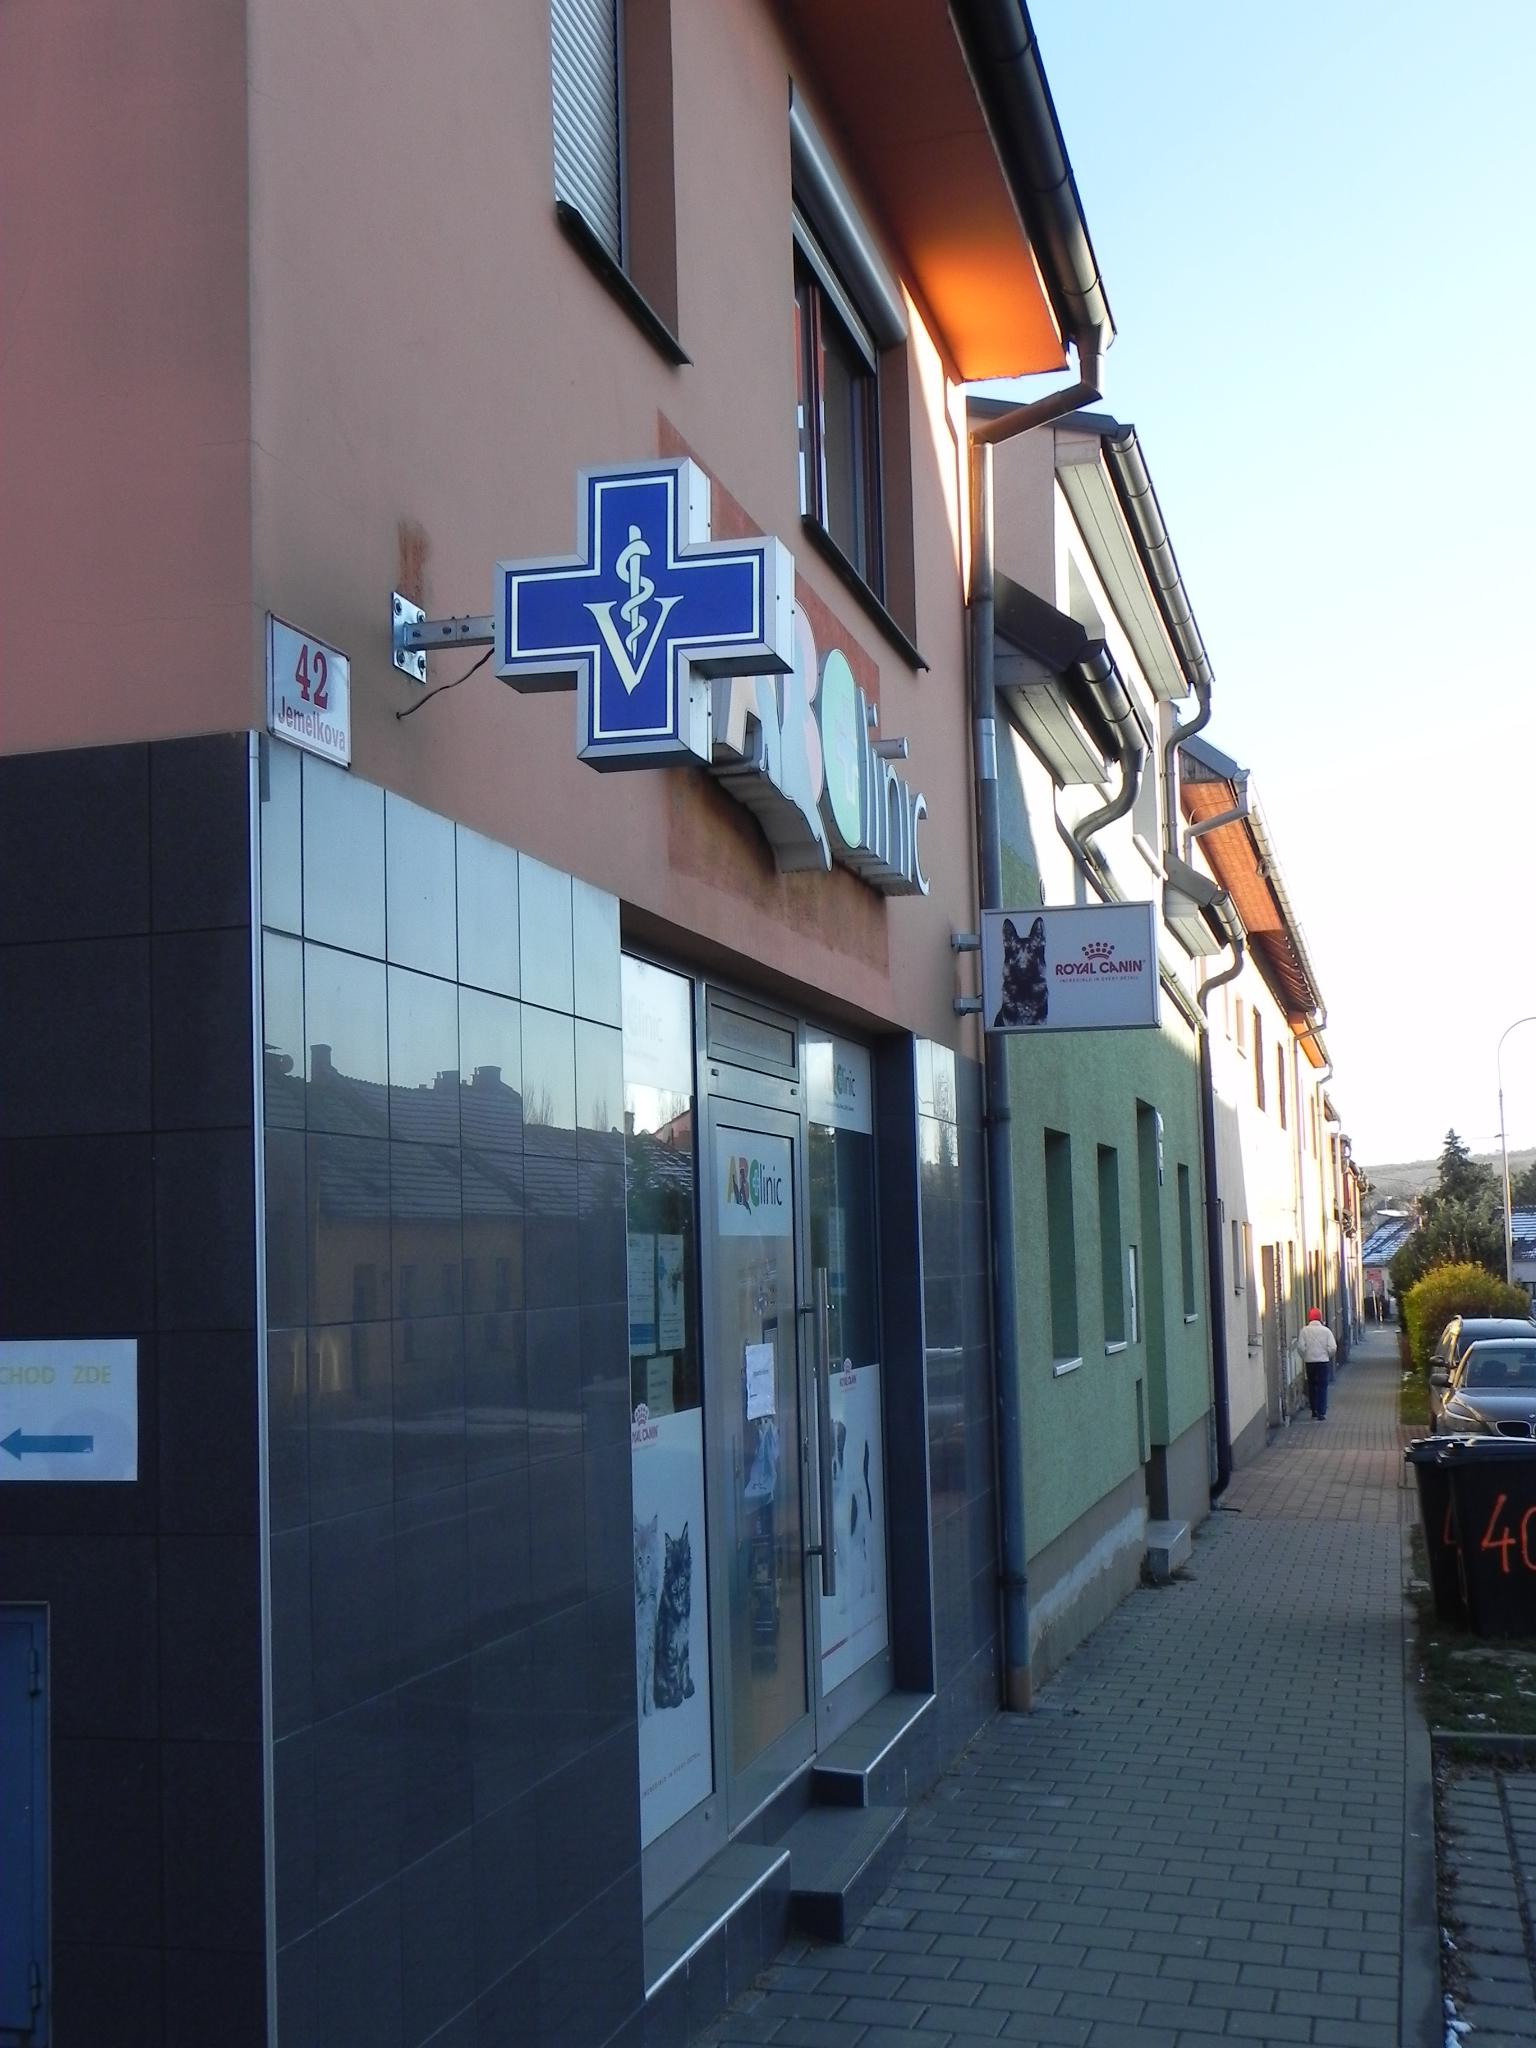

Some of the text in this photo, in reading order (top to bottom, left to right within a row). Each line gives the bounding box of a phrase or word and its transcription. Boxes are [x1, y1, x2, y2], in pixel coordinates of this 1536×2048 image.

[295, 644, 329, 710] 42
[278, 695, 346, 753] Jemelkova
[1056, 960, 1142, 976] ROYAL CANIN
[73, 1365, 112, 1384] ZDE
